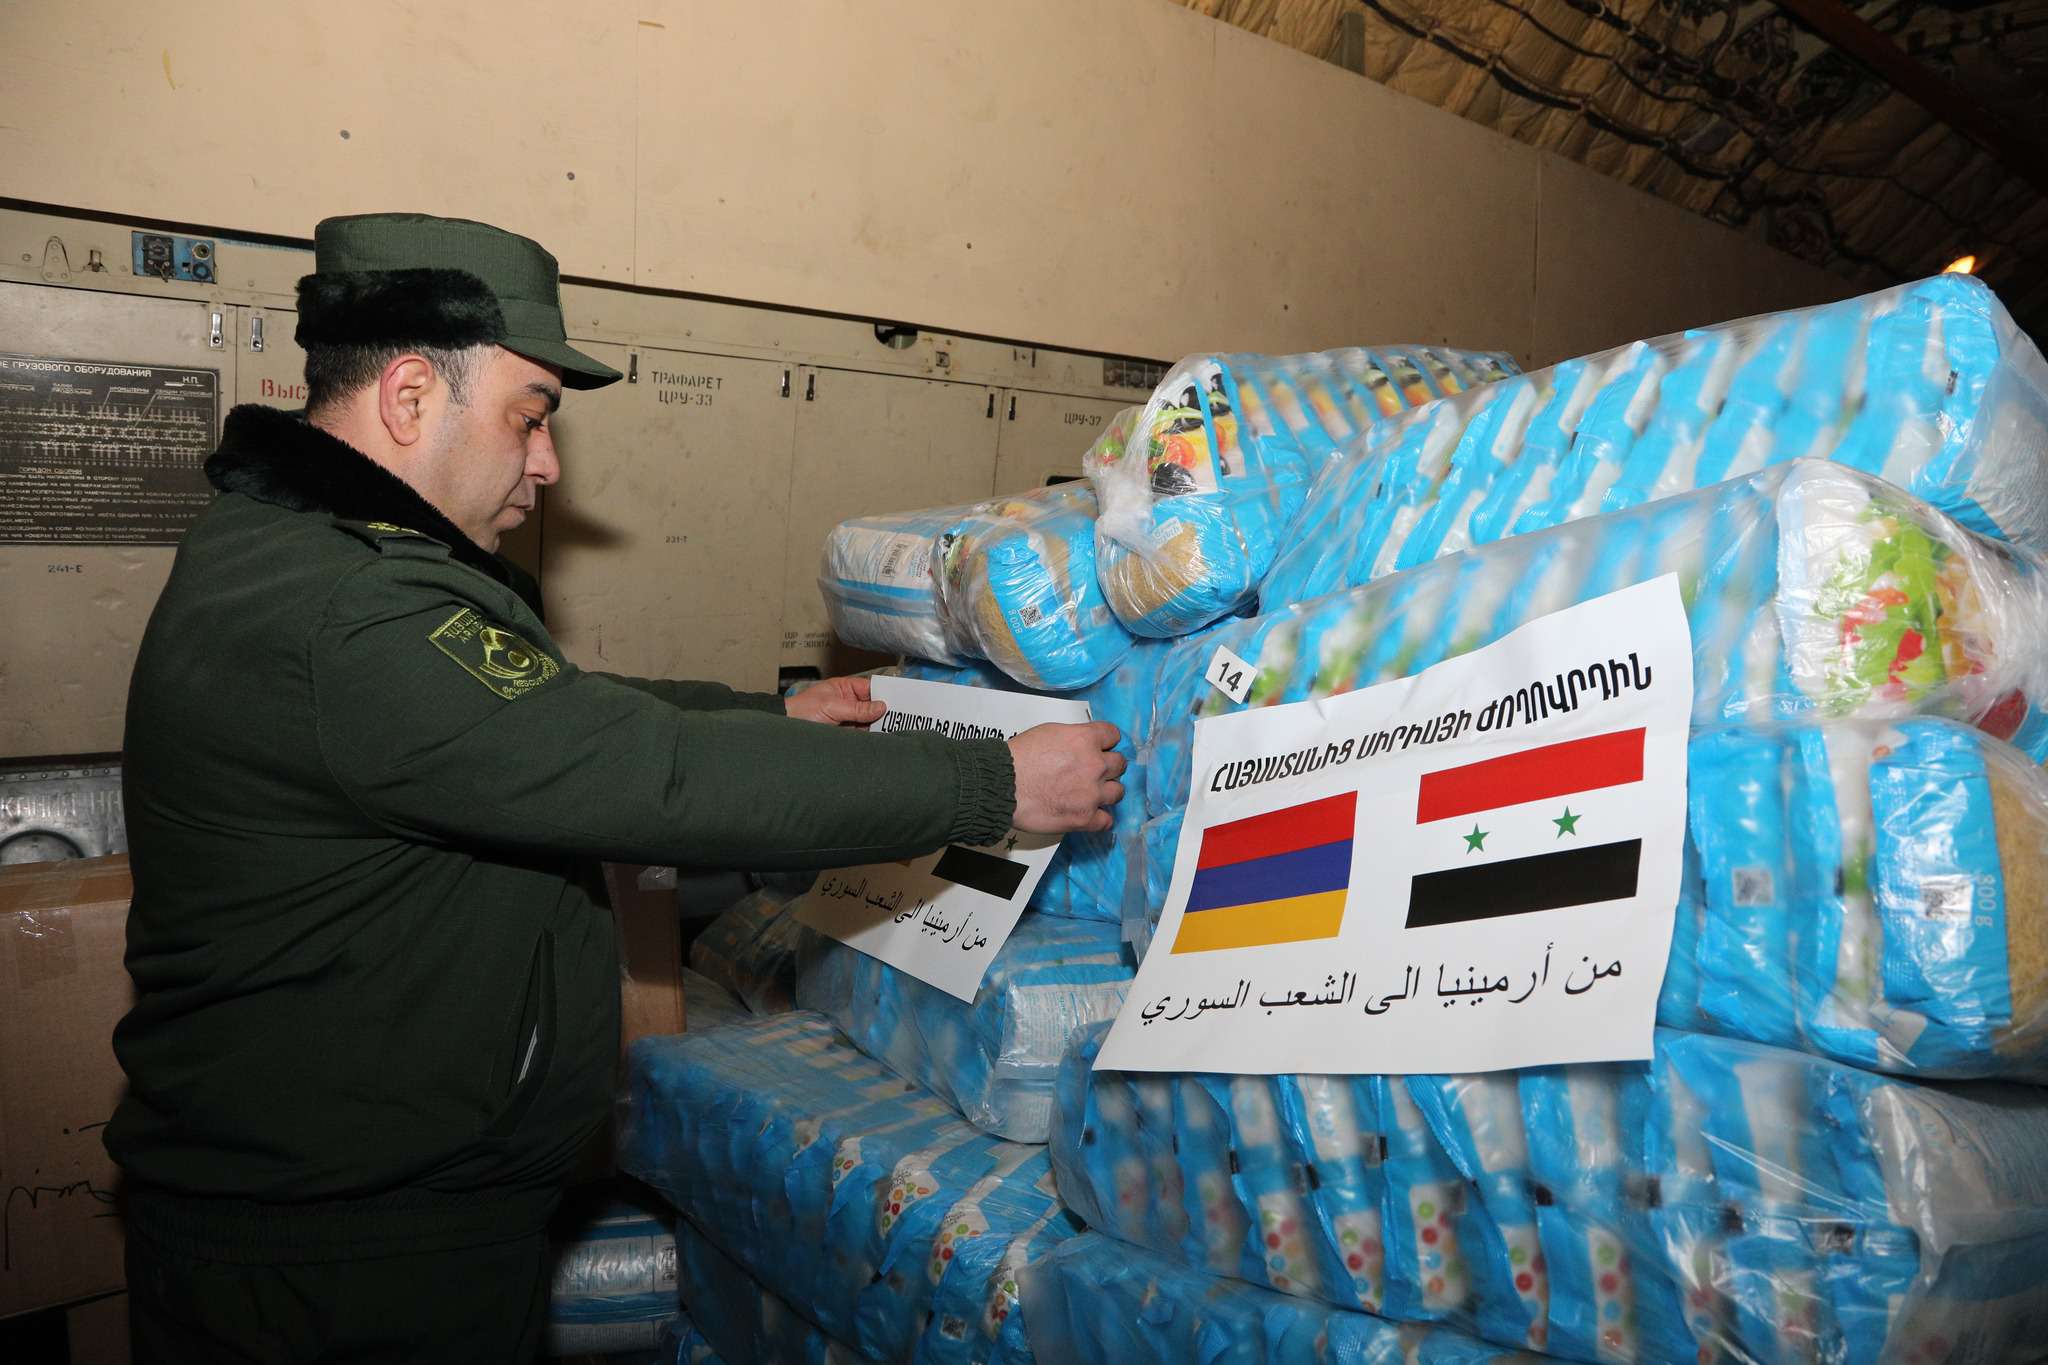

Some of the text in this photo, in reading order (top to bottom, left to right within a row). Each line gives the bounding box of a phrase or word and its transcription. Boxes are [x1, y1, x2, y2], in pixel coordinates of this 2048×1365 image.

[13, 361, 71, 373] ГРУЗОВОГО
[74, 365, 152, 377] ОБОРУДОВАНИЯ
[651, 371, 723, 390] ТРАФАРЕТ
[1217, 661, 1244, 693] 14
[1210, 652, 1652, 793] ՀԱՅԱՍՏԱՆԻՑ ՍԻՐԻԱՅԻ ԺՈՂՈՎՐԴԻՆ
[821, 877, 867, 899] السوري
[865, 888, 904, 911] الشعب
[921, 904, 974, 943] أرمينيا
[961, 927, 988, 951] من
[1436, 941, 1554, 1009] أرمينيا
[1563, 955, 1622, 995] من
[1140, 978, 1251, 1026] السوري
[1258, 970, 1357, 1016] الشعب
